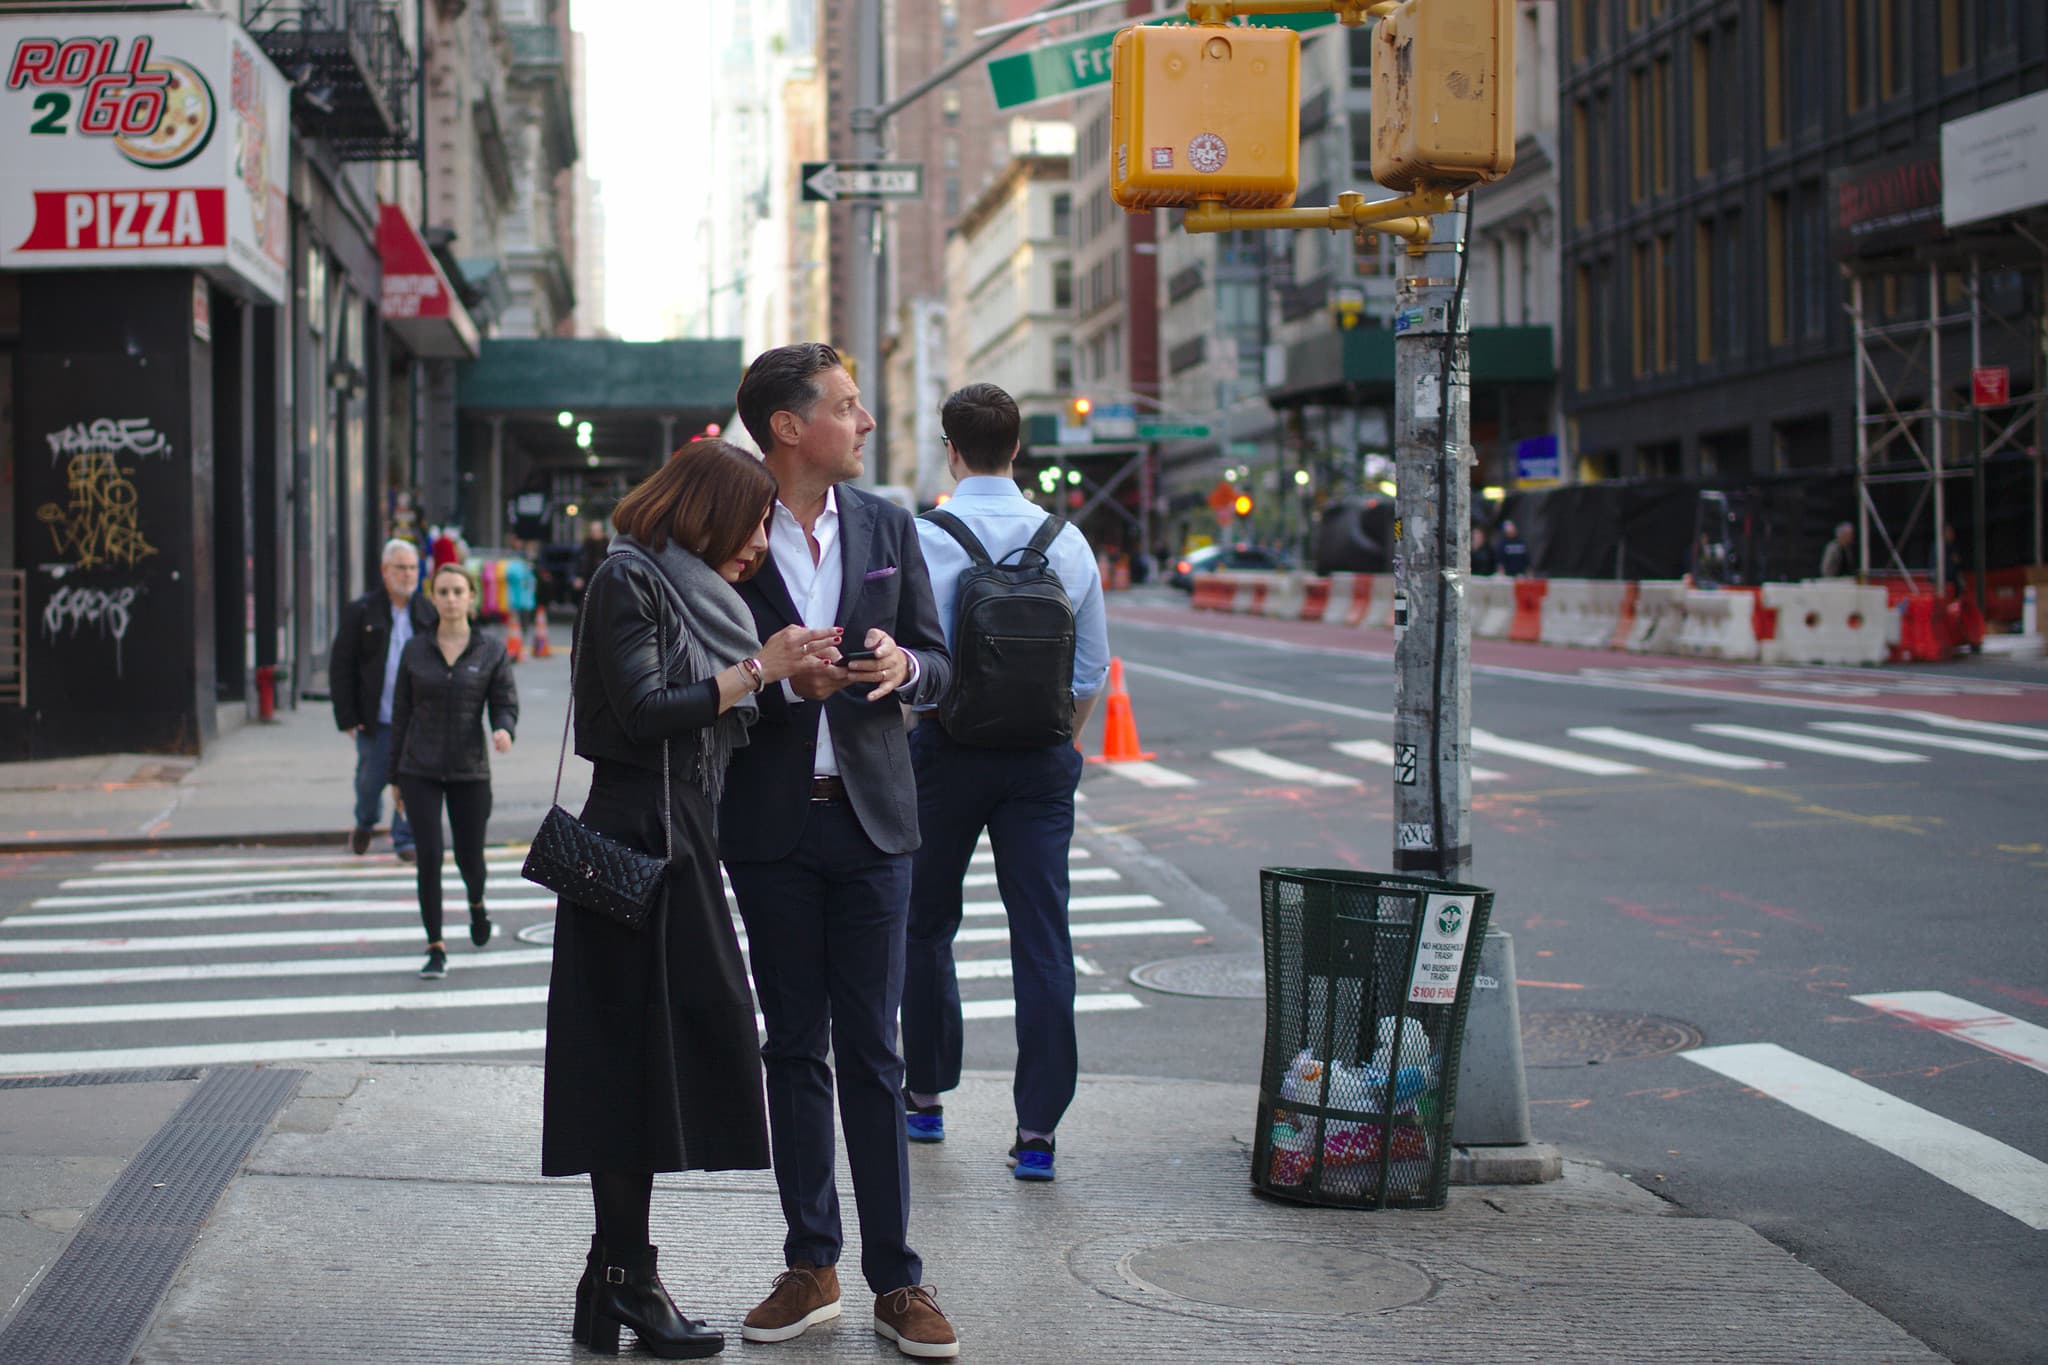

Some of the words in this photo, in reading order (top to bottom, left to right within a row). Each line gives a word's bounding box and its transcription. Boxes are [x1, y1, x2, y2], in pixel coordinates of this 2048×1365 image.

[8, 35, 174, 90] ROLL
[29, 92, 72, 135] 2
[78, 73, 169, 138] GO
[821, 173, 858, 191] ONE
[869, 174, 906, 189] WAY
[65, 190, 204, 248] PIZZA
[1421, 941, 1431, 950] NO
[1432, 942, 1464, 952] HOUSEHOLD
[1434, 951, 1454, 960] TRASH
[1421, 963, 1431, 972] NO
[1432, 964, 1458, 972] BUSINESS
[1430, 972, 1449, 981] TRASH
[1412, 986, 1436, 998] $100
[1437, 987, 1455, 998] FINE
